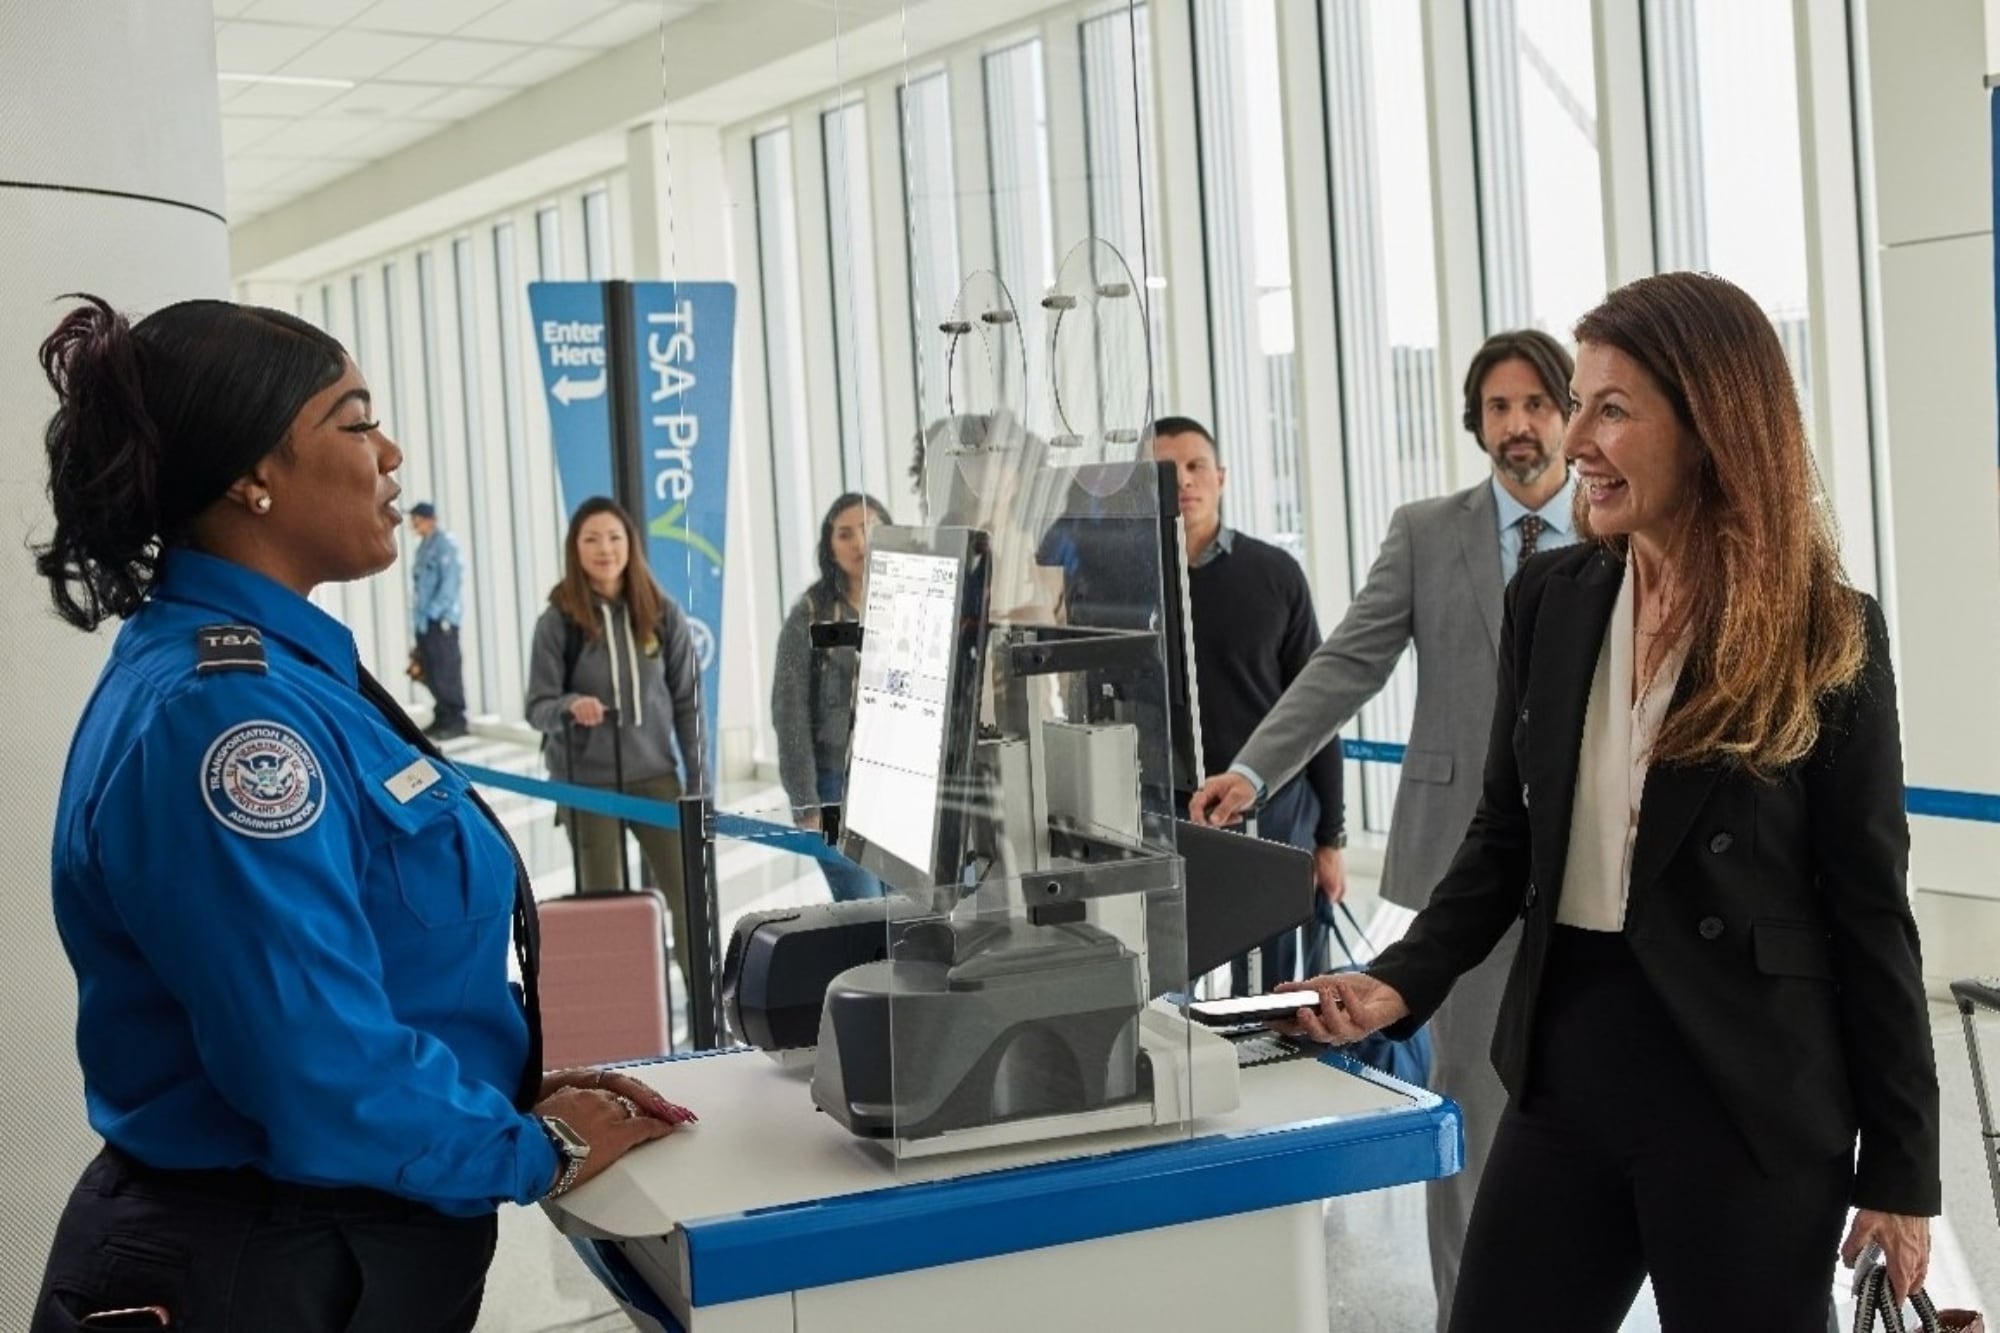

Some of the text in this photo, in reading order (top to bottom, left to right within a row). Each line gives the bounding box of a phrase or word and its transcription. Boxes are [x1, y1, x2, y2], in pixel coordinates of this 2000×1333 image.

[542, 321, 605, 344] Enter
[551, 344, 606, 366] Here
[648, 300, 699, 500] TSA Pre
[203, 634, 262, 647] TSA
[210, 728, 318, 791] TRANSPORTATION SECURITY
[227, 800, 316, 830] ADMINISTRATION
